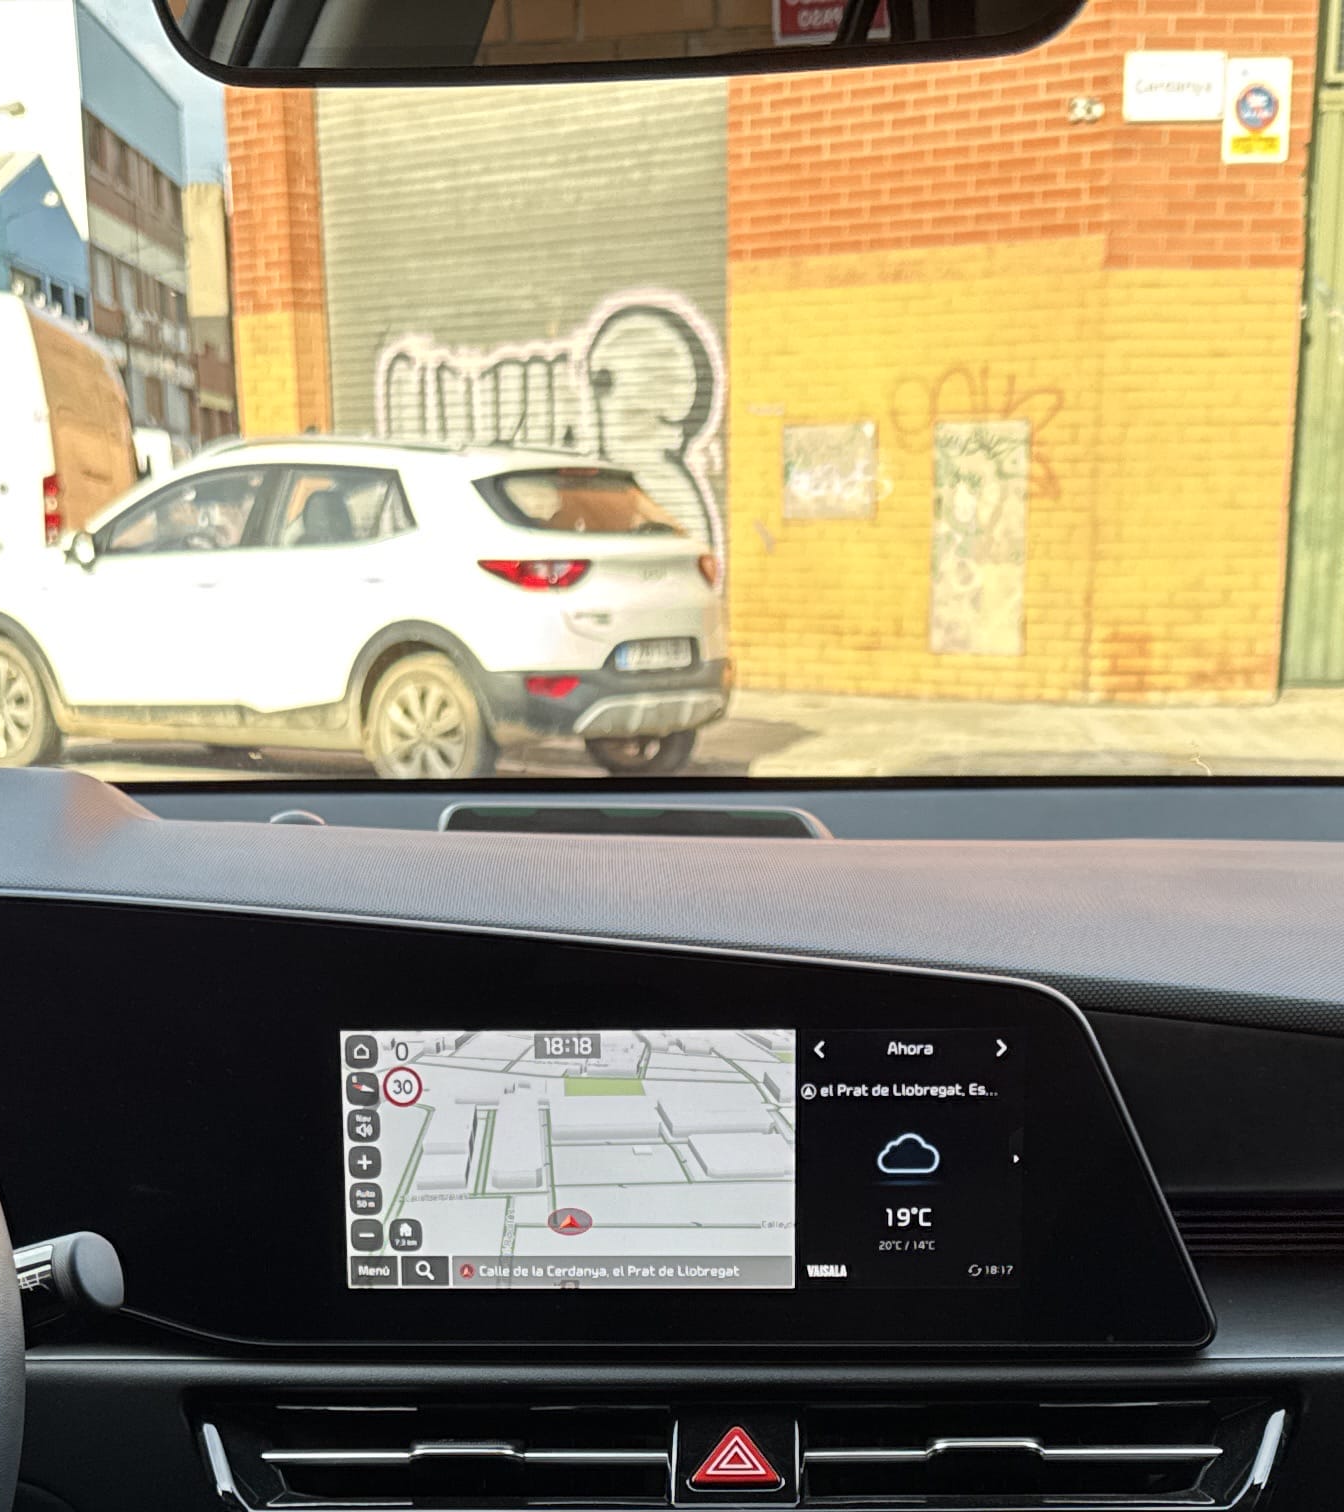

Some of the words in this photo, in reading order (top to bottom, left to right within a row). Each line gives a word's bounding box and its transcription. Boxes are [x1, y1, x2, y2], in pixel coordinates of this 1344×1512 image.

[395, 1042, 409, 1061] 0
[543, 1037, 593, 1056] 18:18
[887, 1041, 934, 1056] Ahora
[392, 1079, 413, 1095] 30
[820, 1084, 833, 1097] el
[837, 1084, 868, 1097] Prat
[872, 1084, 889, 1097] de
[886, 1207, 932, 1227] 19°C
[358, 1265, 391, 1277] Menú
[479, 1265, 510, 1277] Calle
[513, 1265, 529, 1277] de
[532, 1265, 544, 1277] la
[546, 1265, 609, 1280] Cerdanya,
[613, 1265, 625, 1277] el
[628, 1265, 655, 1277] Prat
[658, 1265, 675, 1277] de
[677, 1265, 740, 1280] Llobregat
[806, 1264, 847, 1278] VAISALA
[985, 1265, 1013, 1275] 18:17
